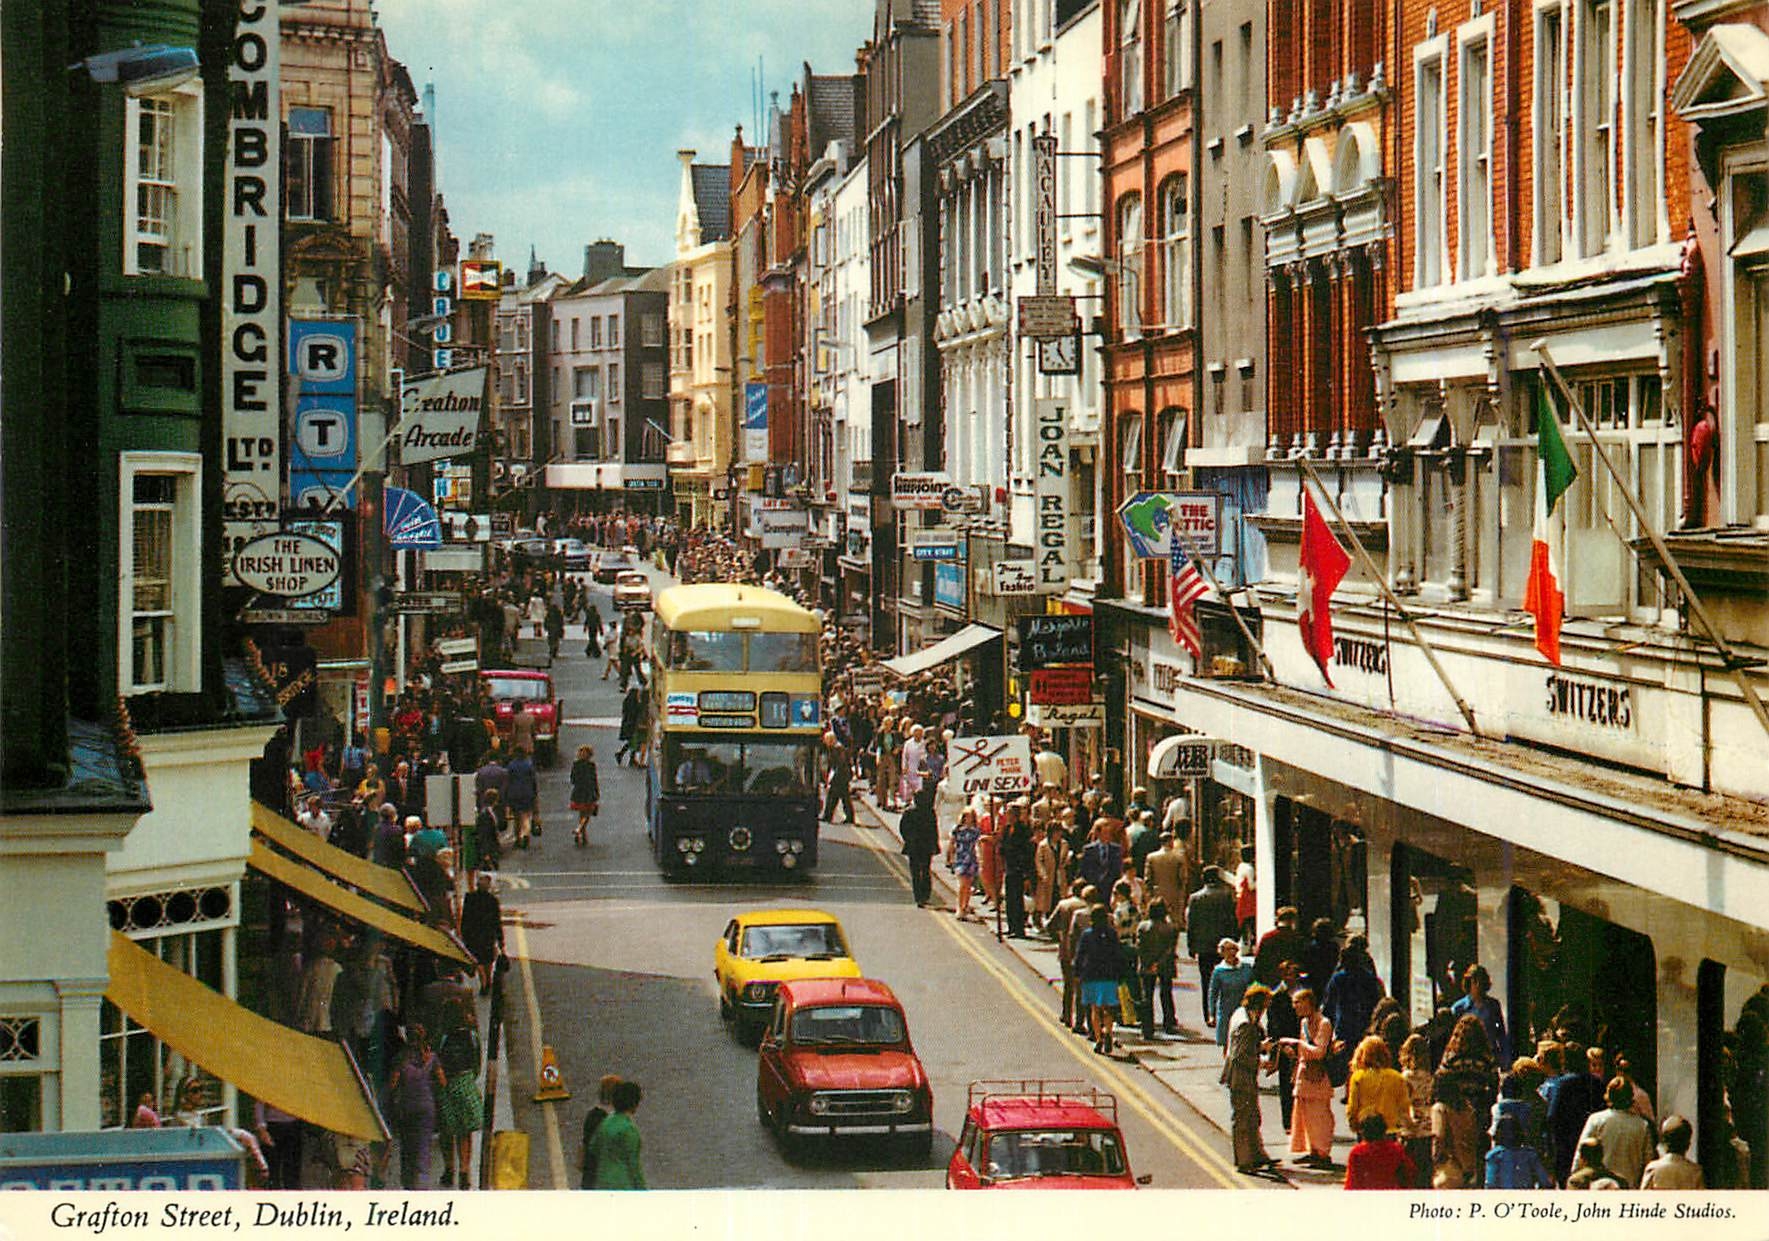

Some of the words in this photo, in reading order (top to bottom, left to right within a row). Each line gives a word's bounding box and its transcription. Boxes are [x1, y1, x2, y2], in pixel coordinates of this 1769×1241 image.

[232, 0, 269, 412] COMBRIDGE
[403, 387, 481, 413] Creation
[403, 424, 473, 448] Arcade
[1039, 406, 1065, 478] JOAN
[1180, 503, 1209, 517] THE
[272, 538, 301, 554] THE
[1040, 495, 1066, 584] REGAL
[239, 556, 283, 573] IRISH
[289, 556, 335, 573] LINEN
[265, 576, 309, 592] SHOP
[1333, 635, 1389, 676] SWITZERS
[1545, 674, 1633, 730] SWITZERS
